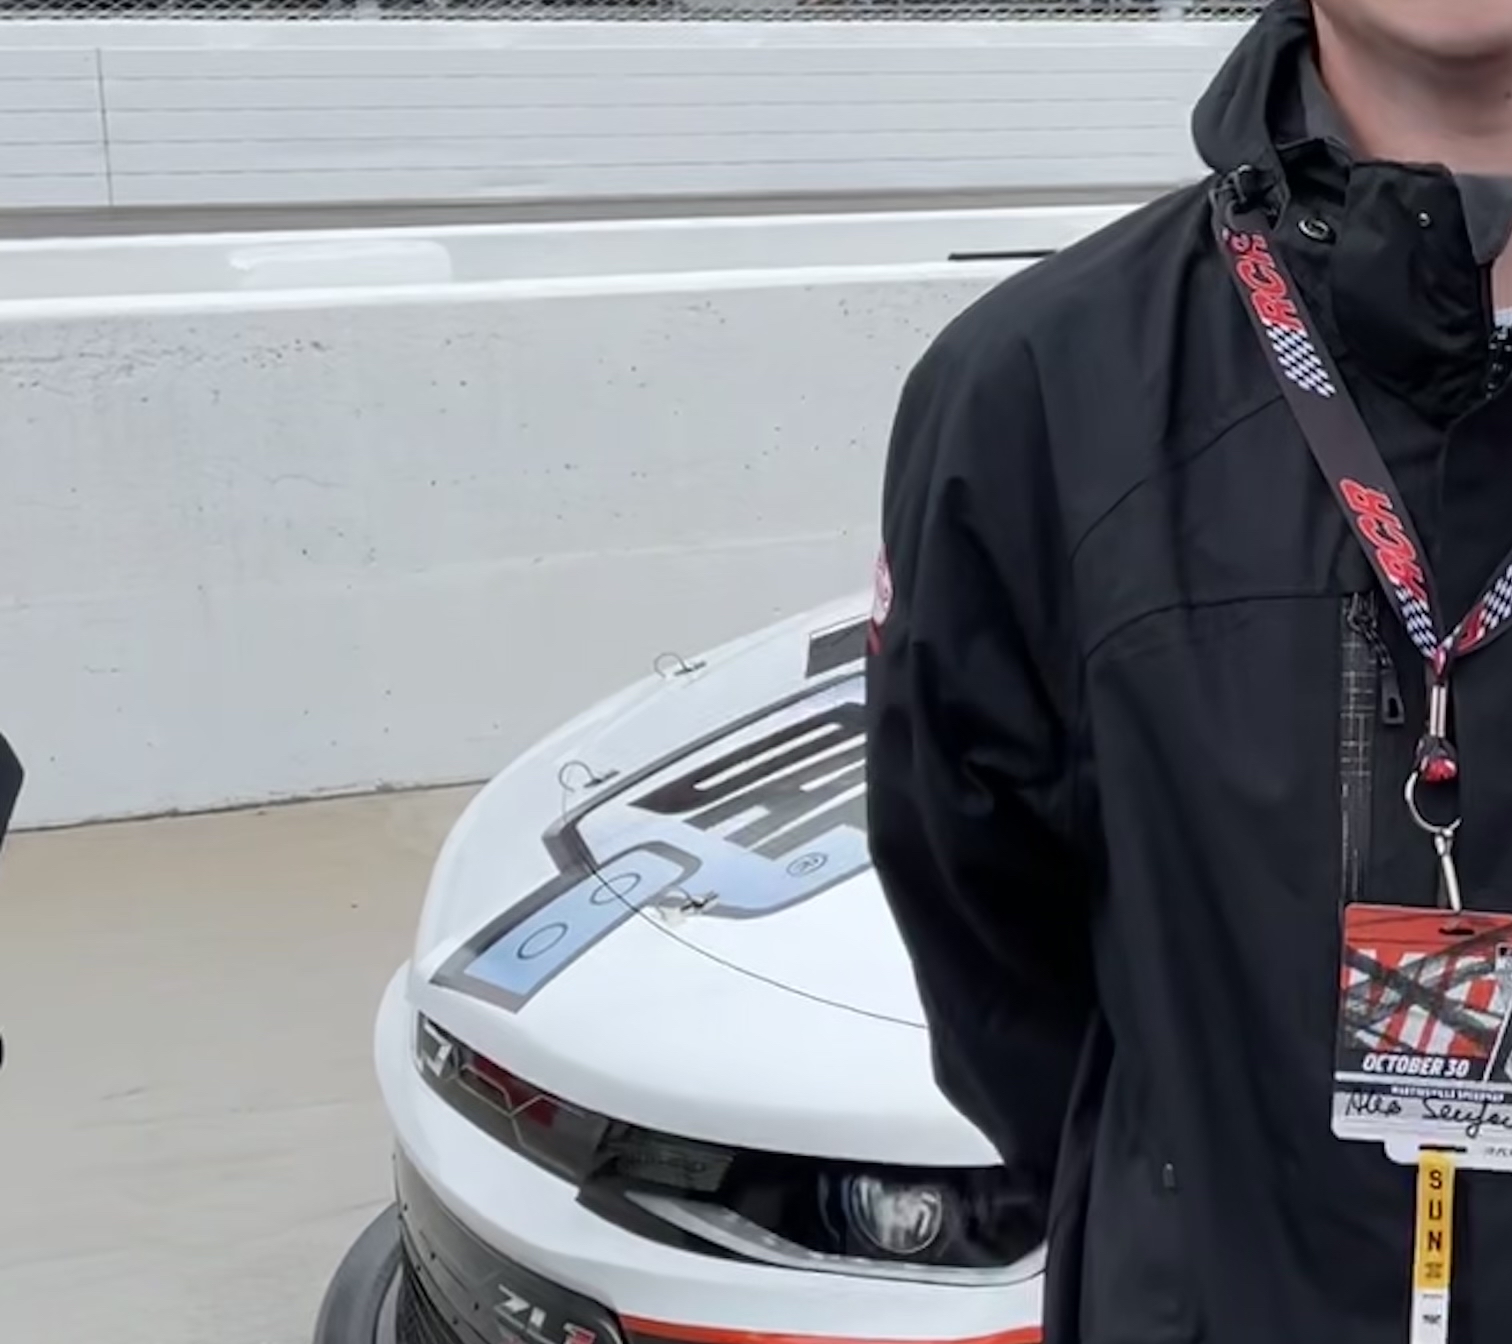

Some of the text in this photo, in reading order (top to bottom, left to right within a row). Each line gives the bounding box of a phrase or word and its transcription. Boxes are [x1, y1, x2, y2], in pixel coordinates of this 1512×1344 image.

[1362, 1052, 1471, 1078] OCTOBER 30
[1428, 1168, 1443, 1252] SUN
